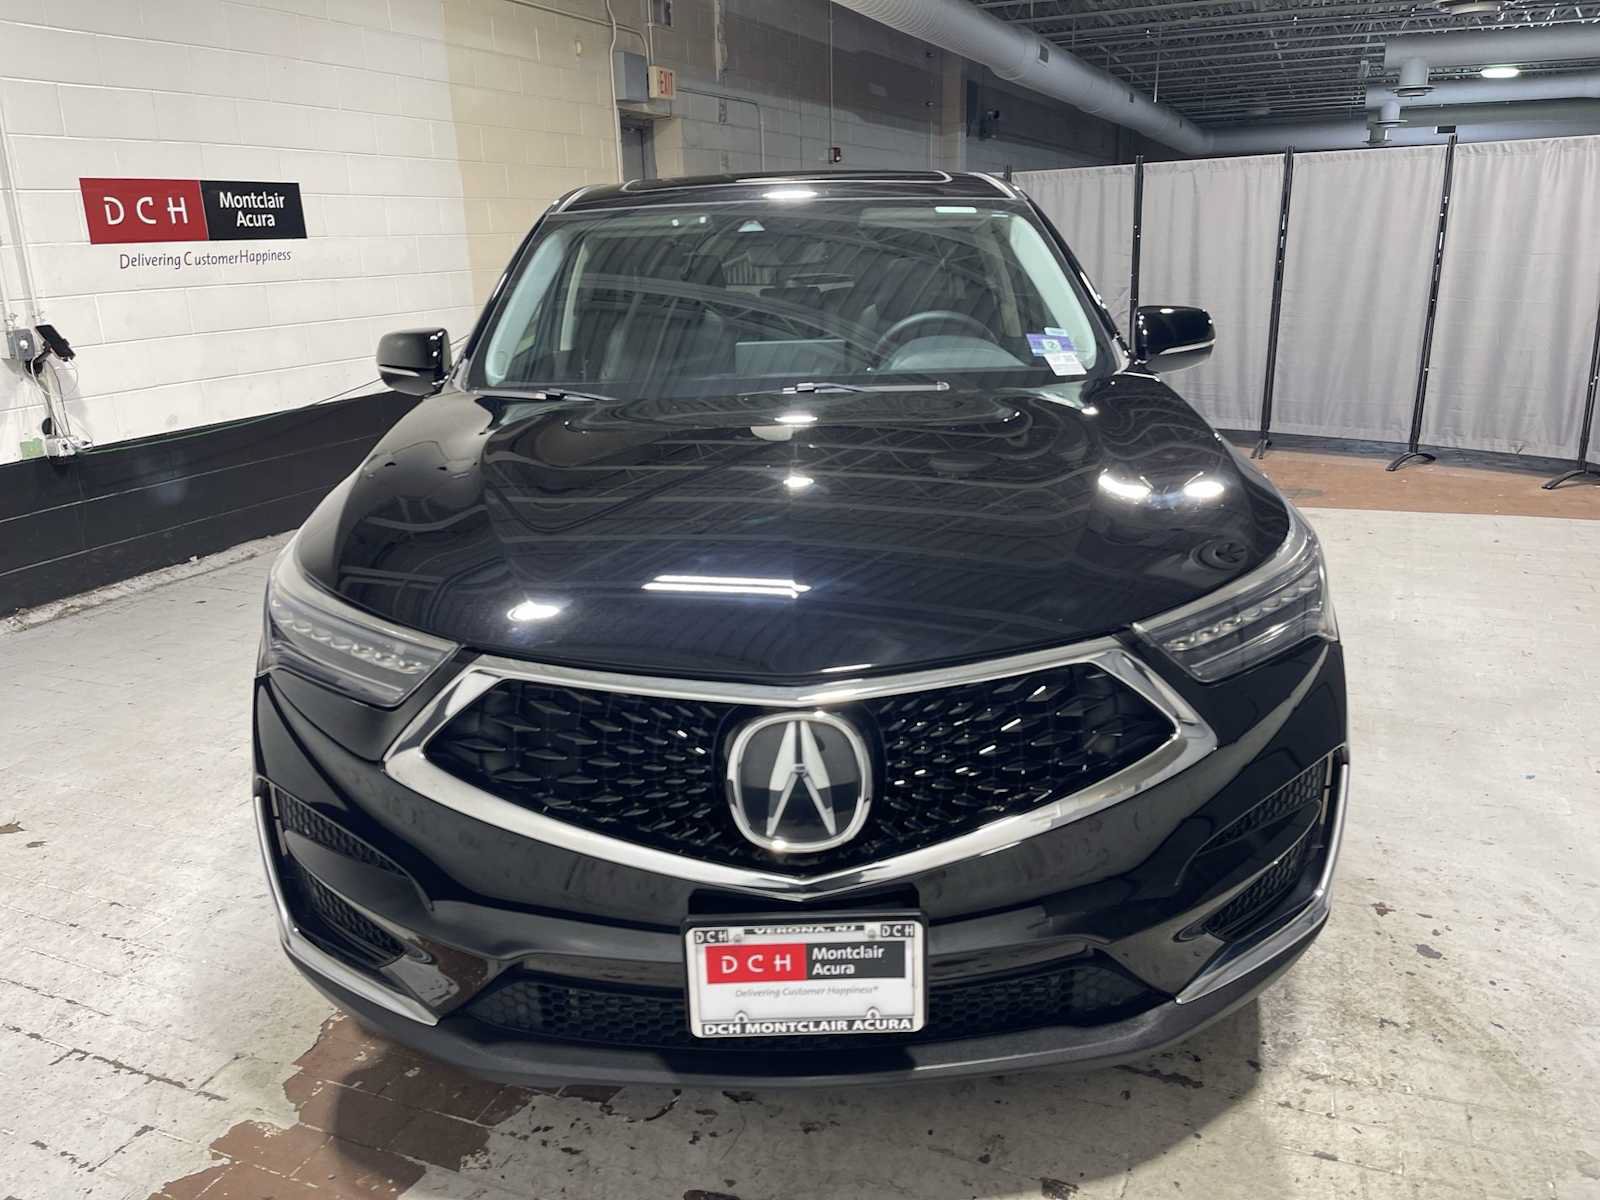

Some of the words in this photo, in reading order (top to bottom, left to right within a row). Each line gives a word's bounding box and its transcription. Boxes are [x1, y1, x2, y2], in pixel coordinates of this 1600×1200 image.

[219, 191, 285, 209] Montclair
[103, 196, 189, 225] DCH
[236, 211, 276, 227] Acura
[119, 253, 181, 270] Delivering
[695, 930, 728, 944] DCH
[881, 924, 914, 937] DCH
[812, 945, 885, 961] Montclair
[721, 954, 792, 975] DCH
[812, 963, 856, 976] Acura
[735, 987, 781, 998] Delivering
[783, 985, 826, 997] Customer
[704, 1023, 741, 1035] DCH
[745, 1020, 849, 1034] MONTCLAIR
[852, 1018, 912, 1031] ACURA
